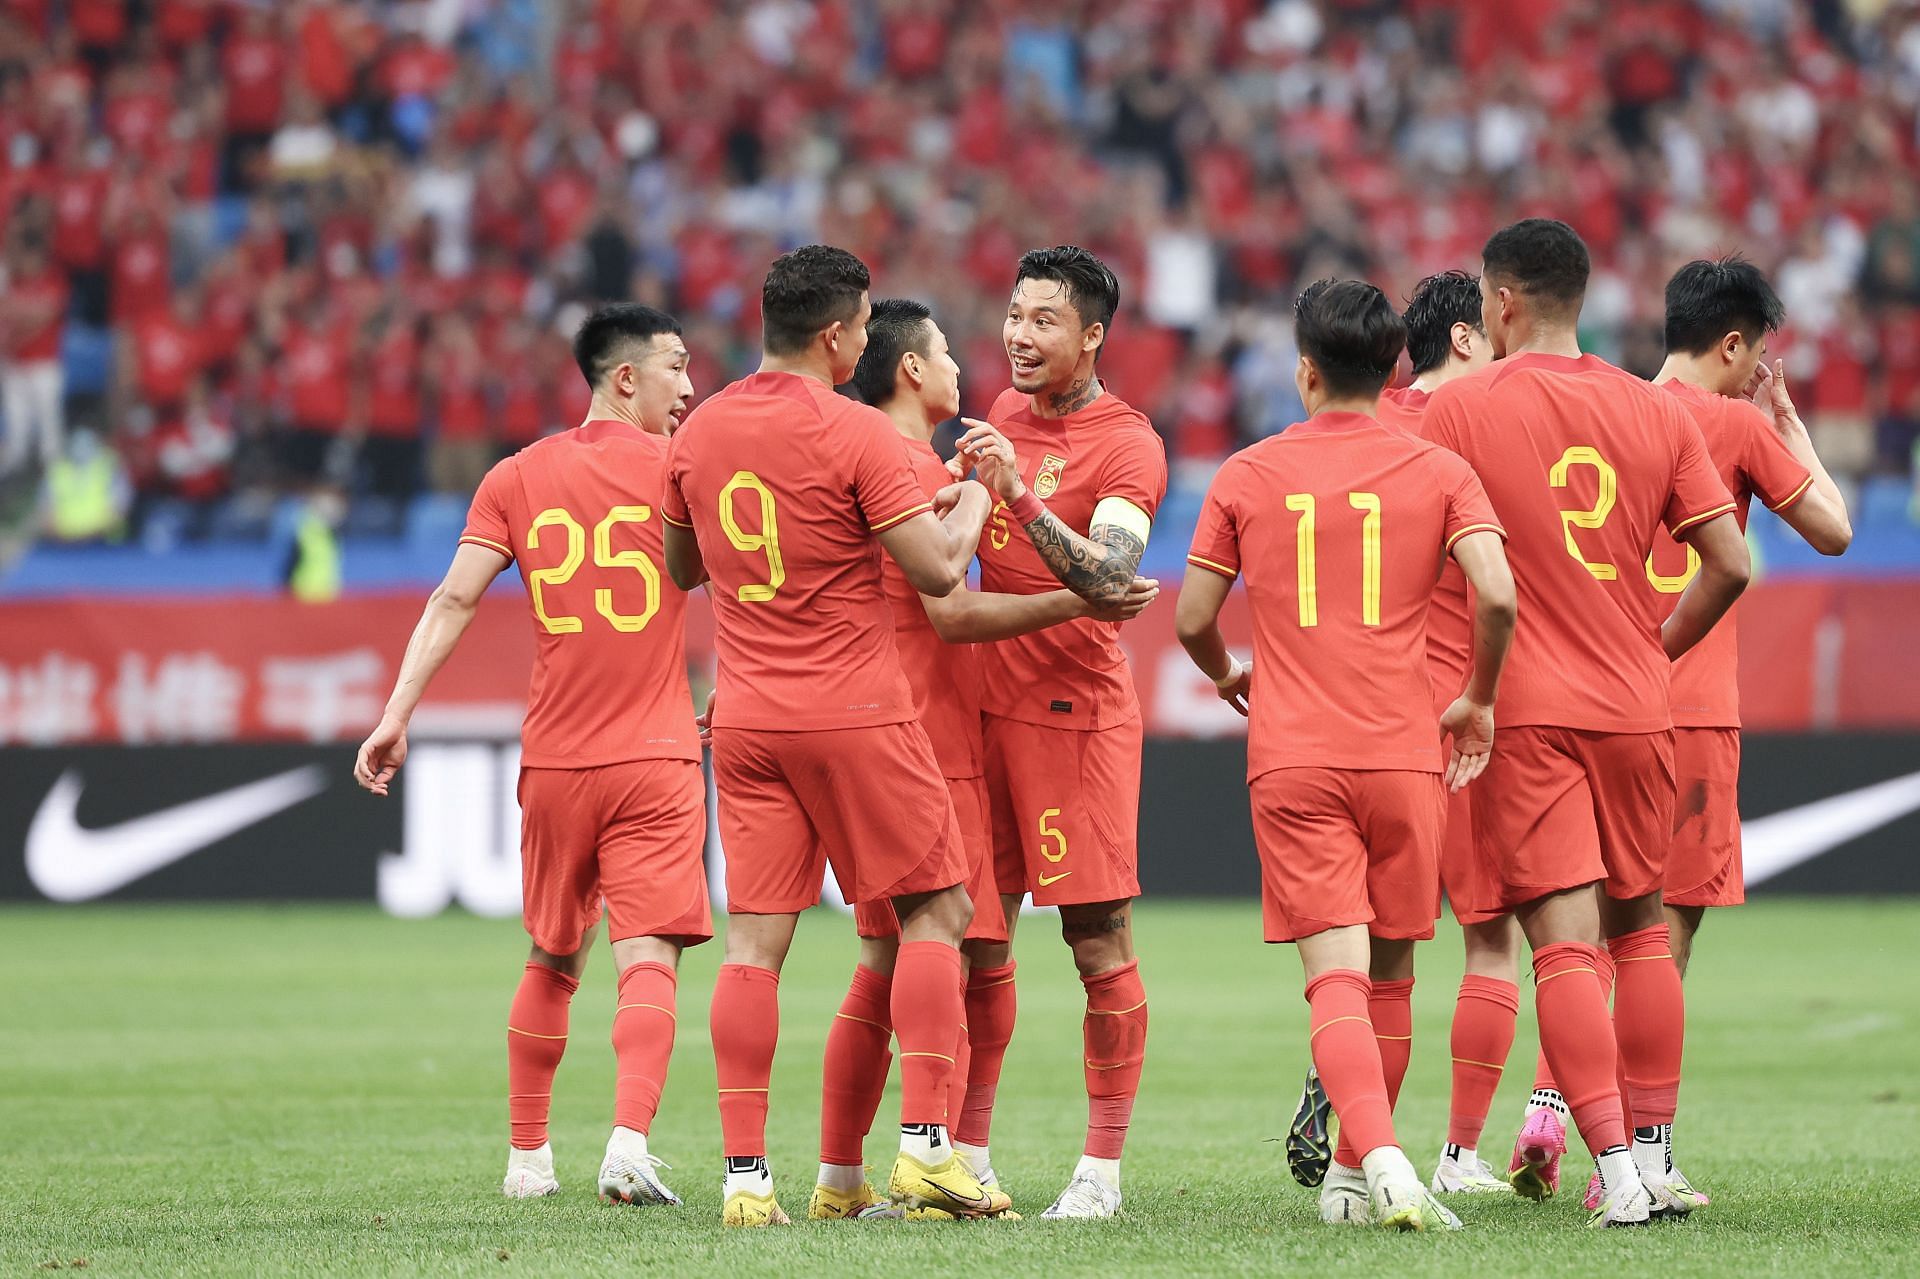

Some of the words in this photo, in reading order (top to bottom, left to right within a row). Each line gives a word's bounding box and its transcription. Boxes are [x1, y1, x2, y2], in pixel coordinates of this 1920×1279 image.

[527, 505, 661, 634] 25
[718, 470, 786, 602] 9
[991, 500, 1010, 550] 5
[1285, 492, 1381, 628] 11
[1549, 446, 1617, 581] 2
[1039, 808, 1067, 863] 5
